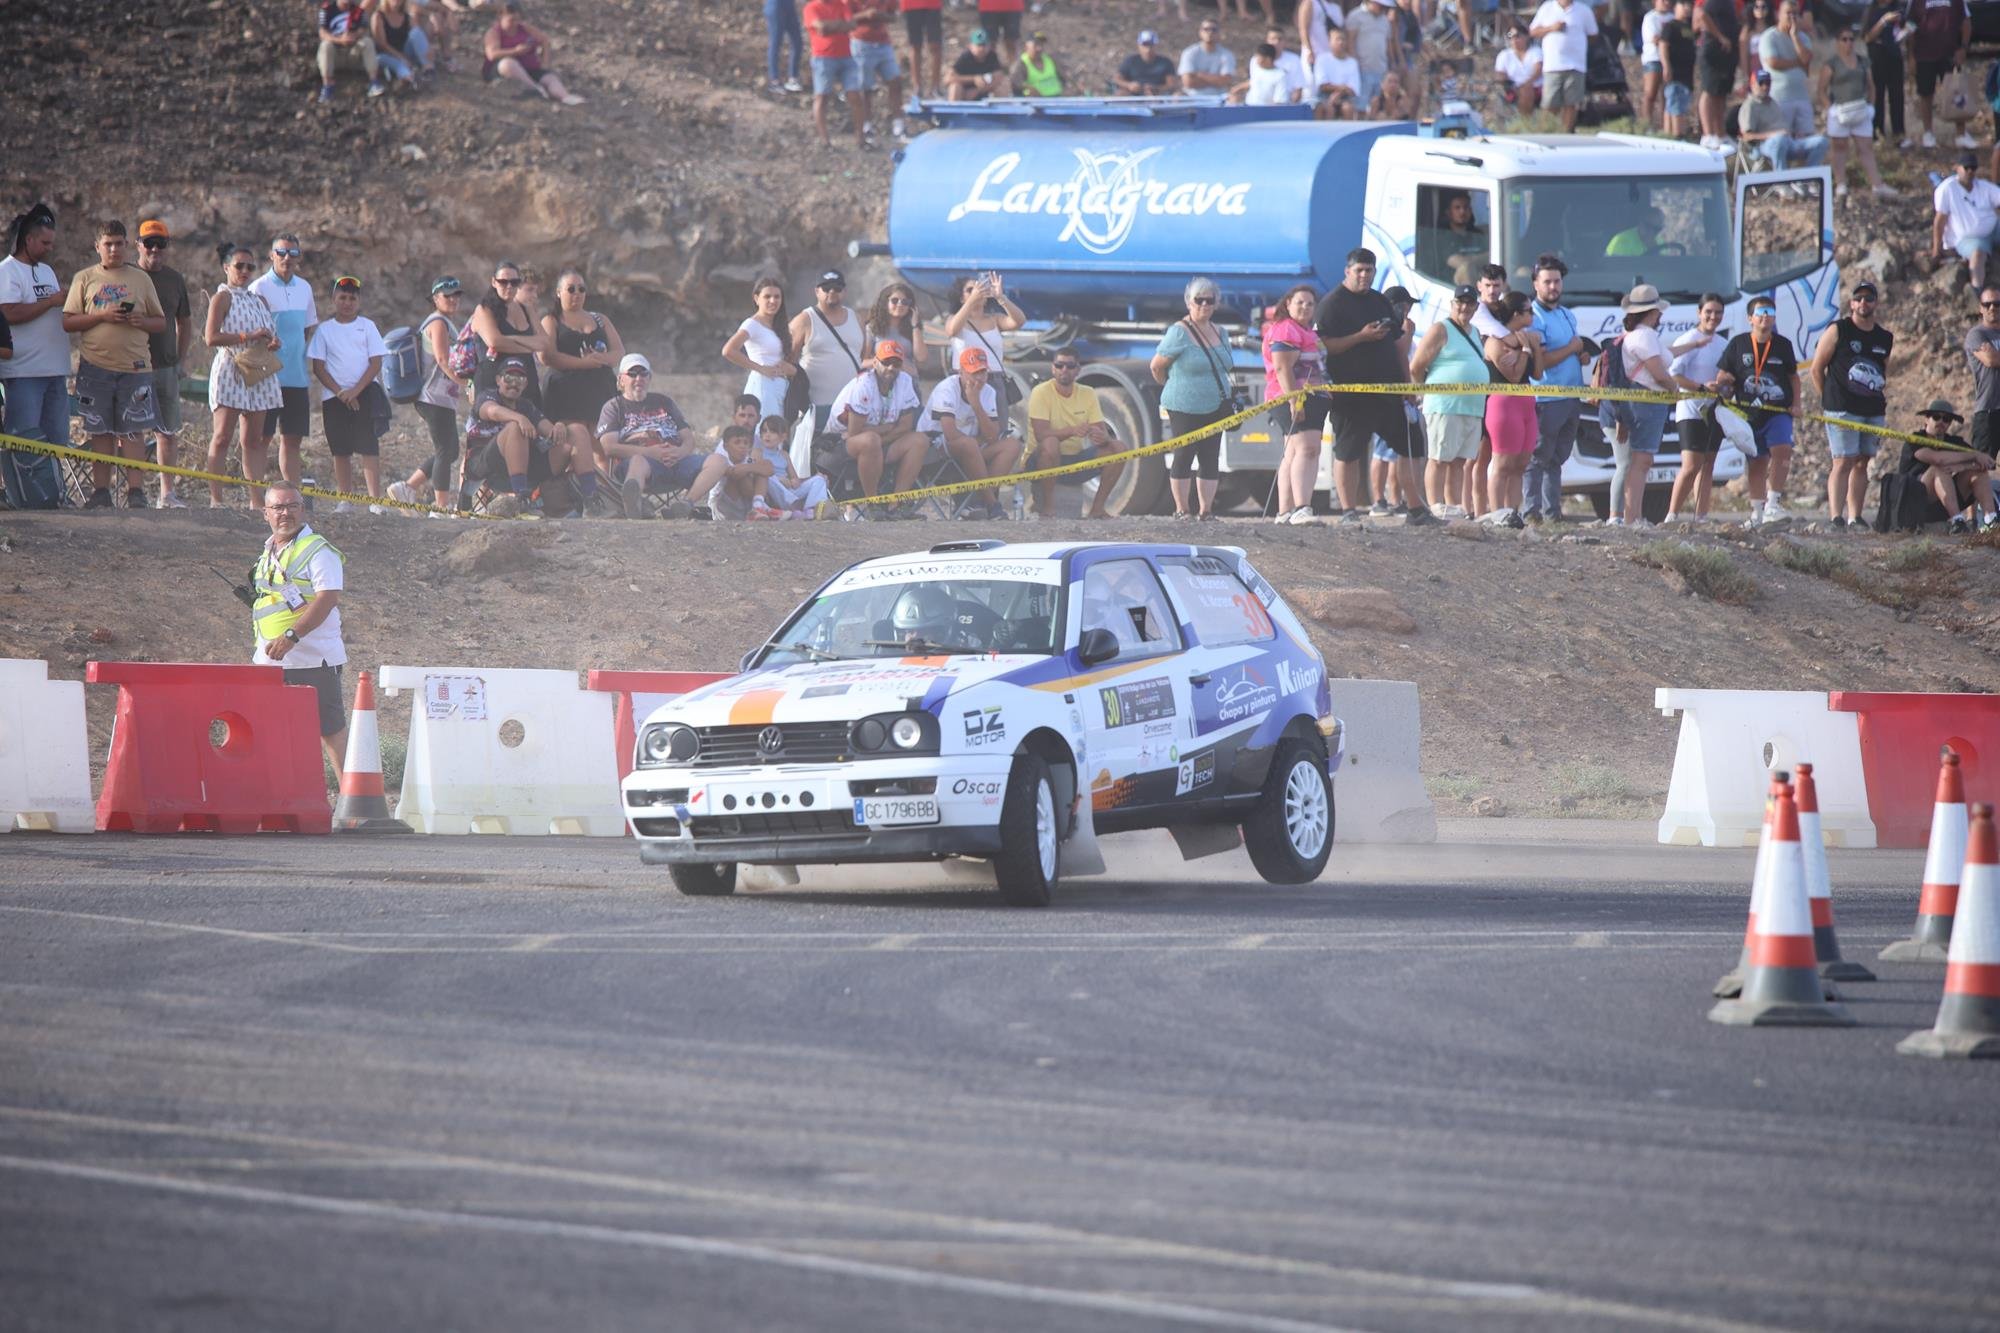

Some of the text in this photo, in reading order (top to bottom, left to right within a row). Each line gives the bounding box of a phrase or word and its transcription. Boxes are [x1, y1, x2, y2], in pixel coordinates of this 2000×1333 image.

[1232, 592, 1273, 637] 30
[1275, 659, 1319, 698] Kilian
[1103, 689, 1120, 727] 30
[1219, 704, 1243, 721] Chapa
[1250, 693, 1277, 713] pintura
[965, 731, 1006, 748] MOTOR
[952, 779, 1001, 795] Oscar
[1195, 768, 1212, 784] TECH
